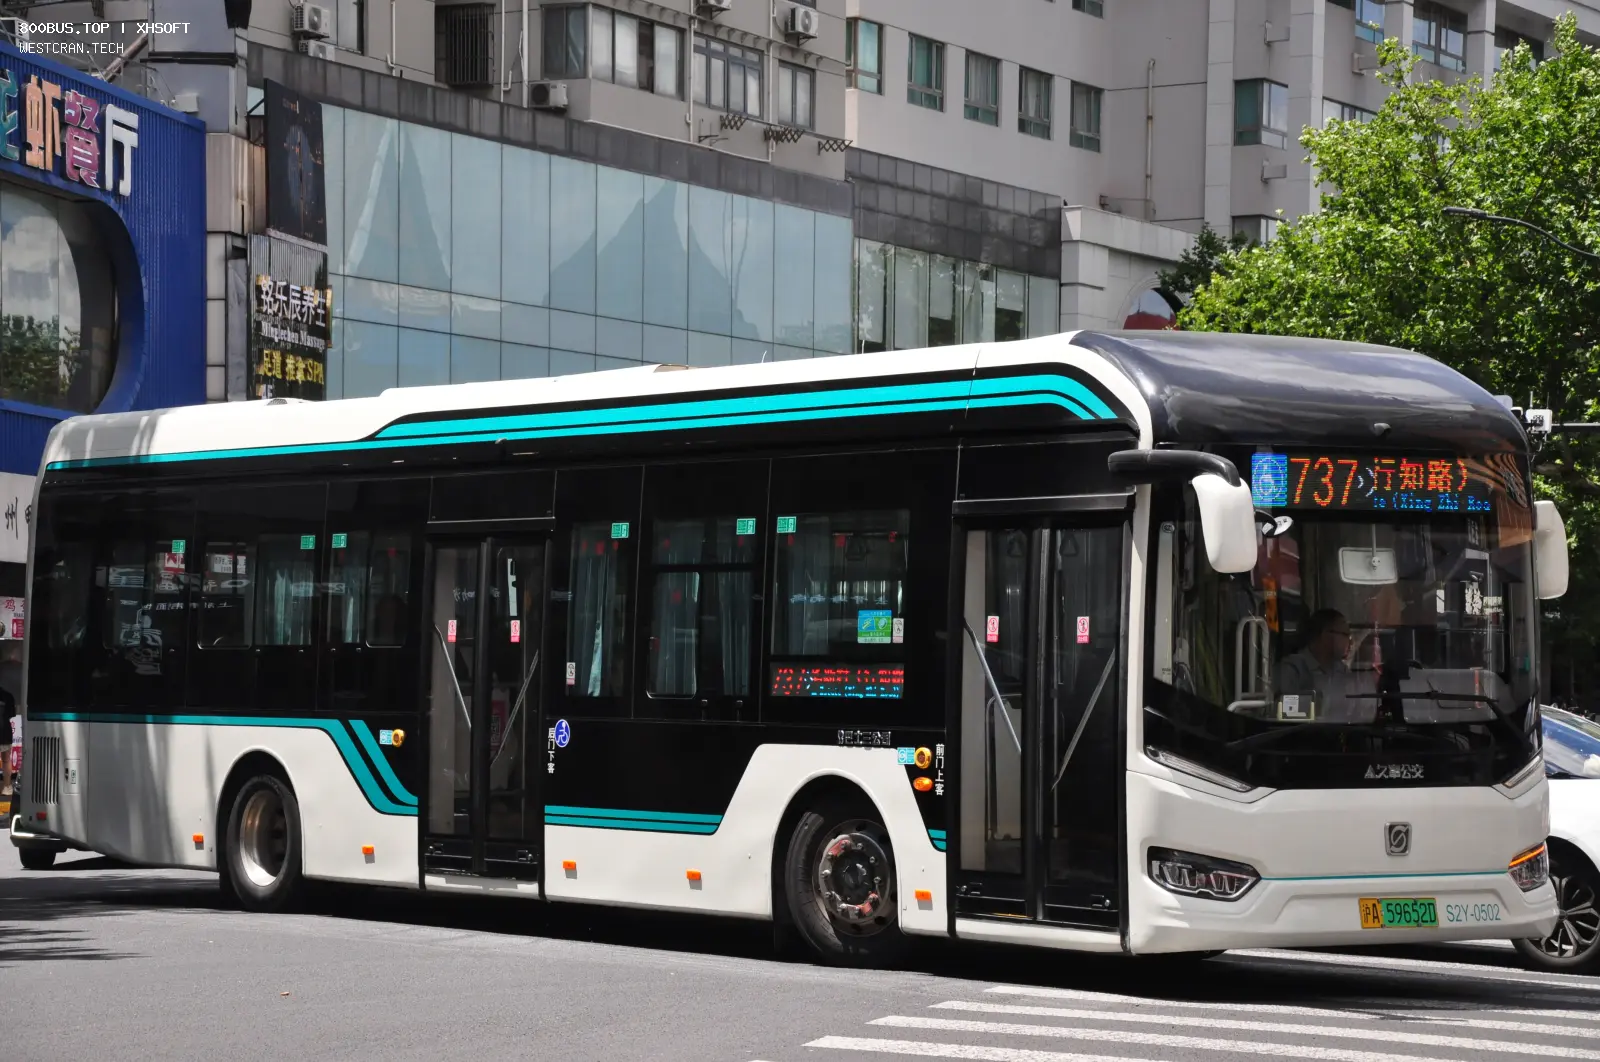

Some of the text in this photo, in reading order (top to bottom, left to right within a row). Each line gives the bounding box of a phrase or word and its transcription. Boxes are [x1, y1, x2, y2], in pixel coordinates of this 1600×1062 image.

[1290, 456, 1358, 507] 737
[935, 743, 945, 796] 前门上客
[1446, 903, 1501, 922] S2Y-0502
